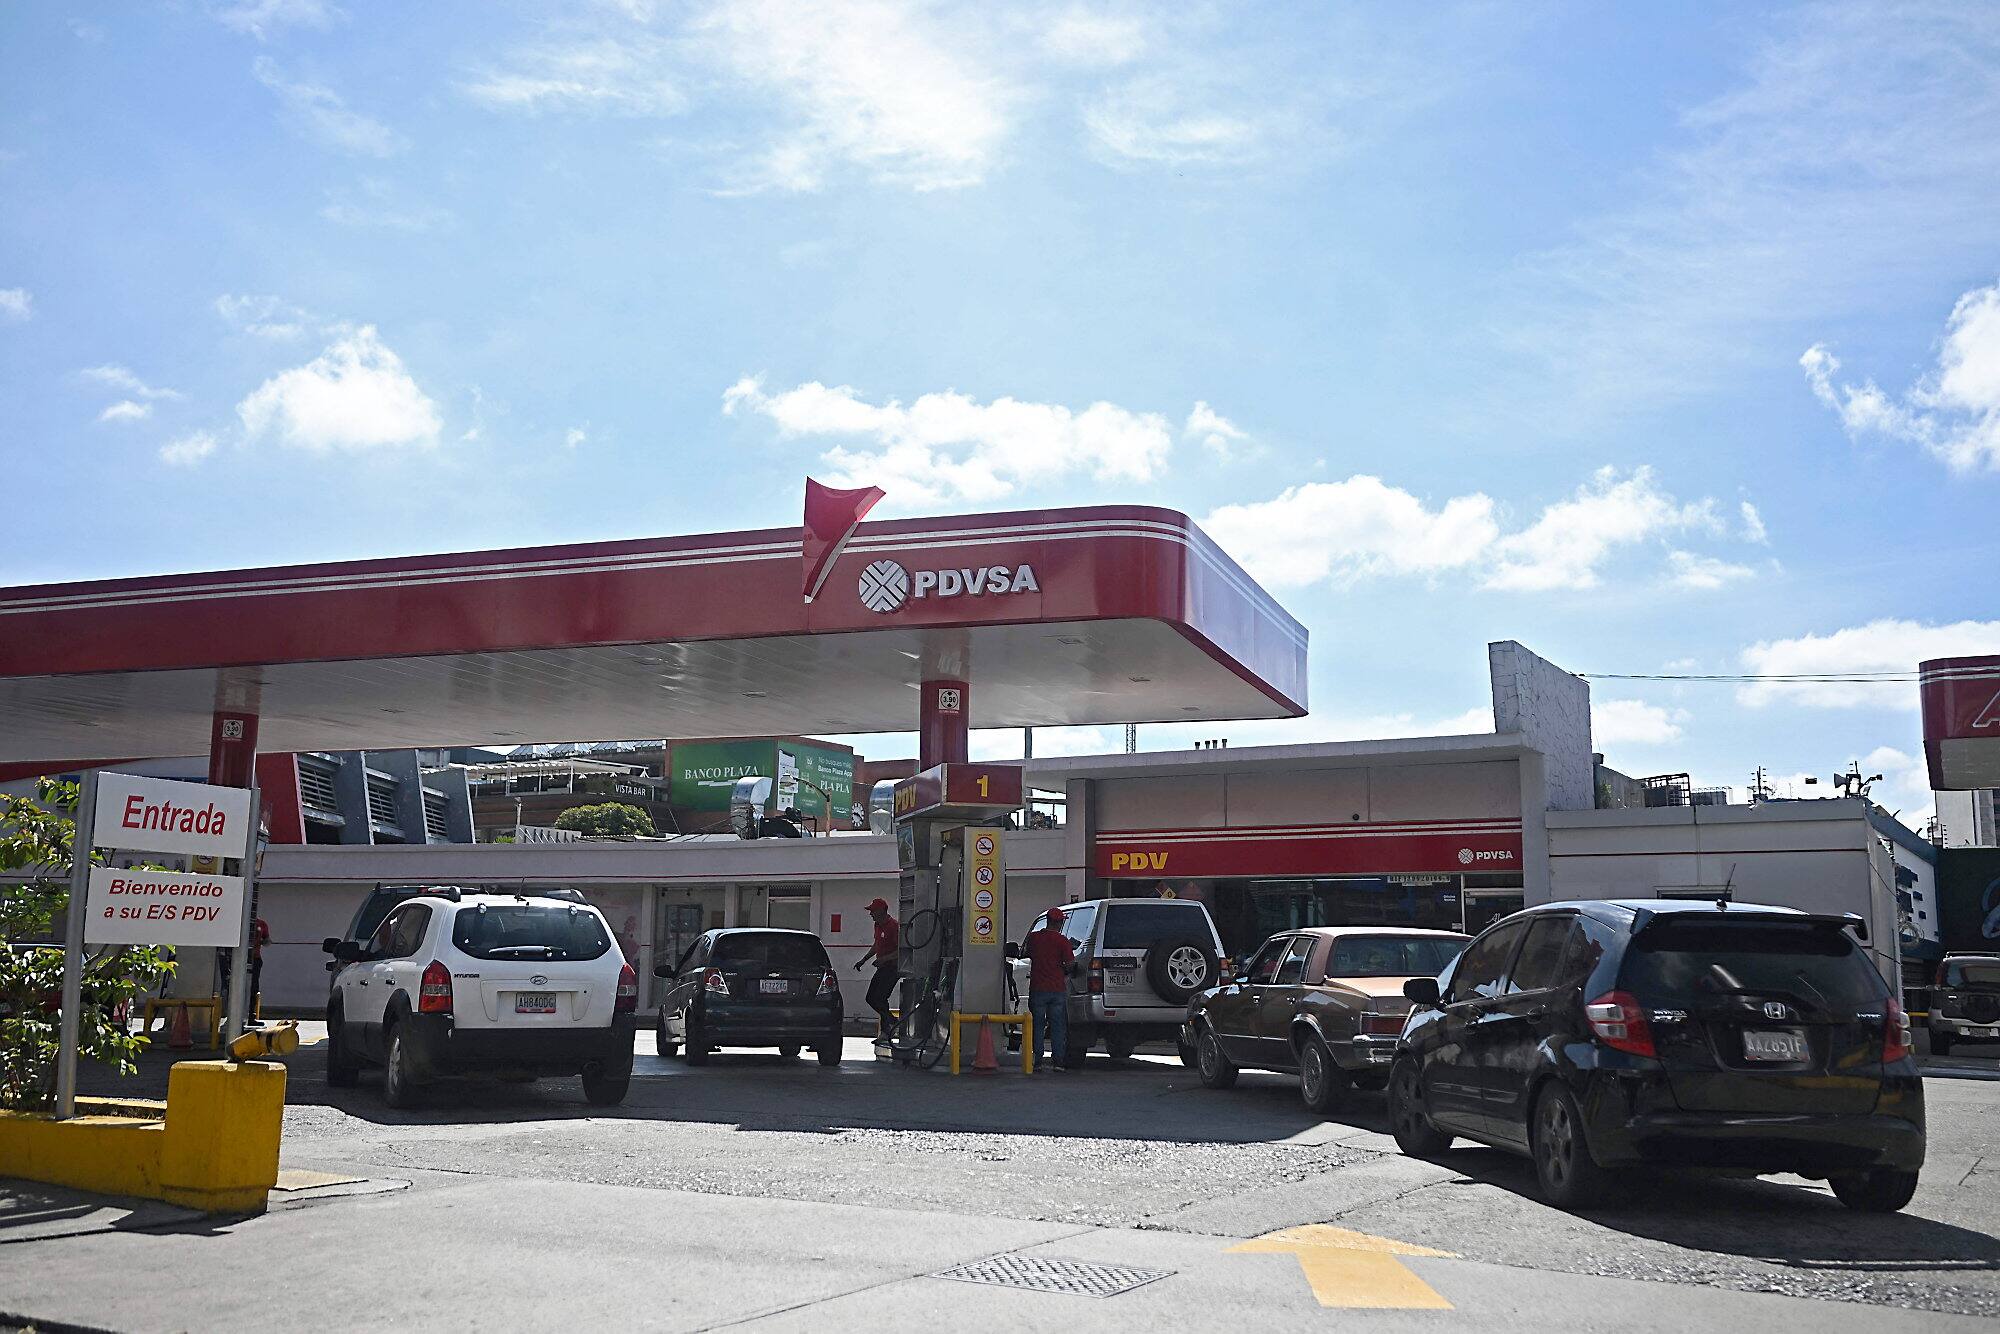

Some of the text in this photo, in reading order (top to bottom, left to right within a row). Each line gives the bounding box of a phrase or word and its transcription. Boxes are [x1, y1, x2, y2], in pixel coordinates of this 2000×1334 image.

[914, 564, 1040, 599] PDVSA
[685, 765, 759, 780] BANCO PLAZA
[818, 765, 832, 773] Banco
[832, 767, 844, 776] Plaza
[615, 784, 646, 796] VISTA BAR
[820, 780, 850, 793] PLA PLA
[976, 774, 989, 797] 1
[895, 783, 917, 813] PDV
[122, 795, 226, 835] Entrada
[1111, 852, 1169, 870] PDV
[1476, 850, 1513, 860] PDVSA
[109, 879, 223, 897] Bienvenido
[104, 904, 220, 921] a su E/S PDV
